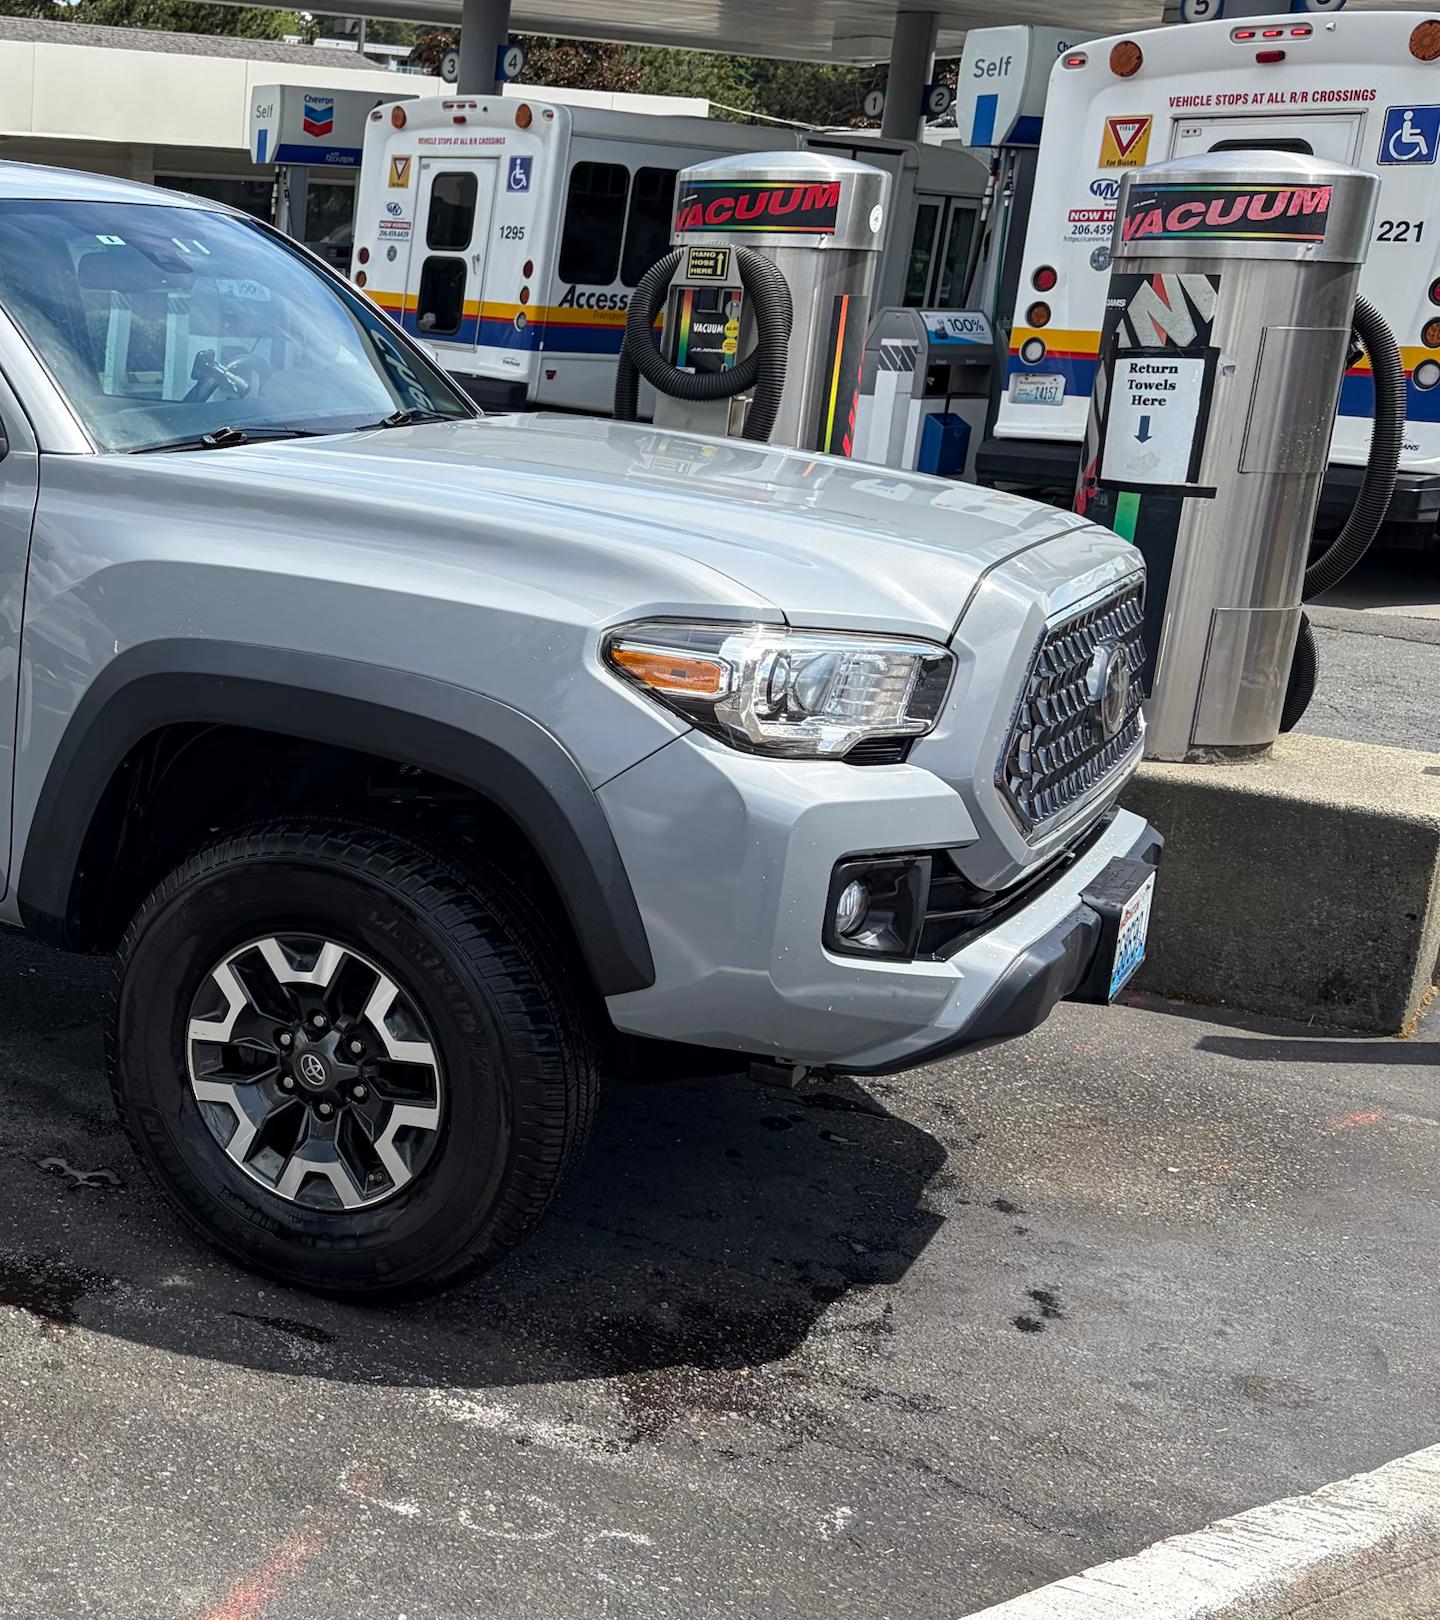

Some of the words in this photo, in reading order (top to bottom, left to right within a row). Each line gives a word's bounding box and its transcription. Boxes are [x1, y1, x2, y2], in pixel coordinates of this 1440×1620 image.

[447, 58, 456, 74] 3
[509, 53, 518, 70] 4
[973, 56, 1012, 78] Self
[304, 94, 334, 104] Chevron
[872, 97, 877, 110] 1
[935, 92, 944, 107] 2
[1169, 95, 1212, 107] VEHICLE
[1215, 93, 1249, 106] STOPS
[1251, 93, 1265, 104] AT
[1267, 92, 1286, 104] ALL
[1289, 91, 1308, 103] R/R
[1312, 89, 1376, 102] CROSSINGS
[256, 104, 274, 119] Self
[418, 137, 437, 145] VEHICLE
[438, 137, 453, 145] STOPS
[478, 137, 506, 145] CROSSINGS
[675, 181, 841, 232] VACUUM
[1122, 186, 1333, 241] VACUUM
[1070, 211, 1101, 221] NOW
[500, 226, 525, 240] 1295
[1376, 221, 1425, 243] 221
[690, 267, 713, 275] HERE
[558, 285, 629, 311] Access
[694, 323, 723, 333] VACUUM
[948, 318, 984, 332] 100%
[1129, 363, 1179, 374] Return
[1127, 379, 1176, 390] Towels
[1131, 395, 1167, 406] Here
